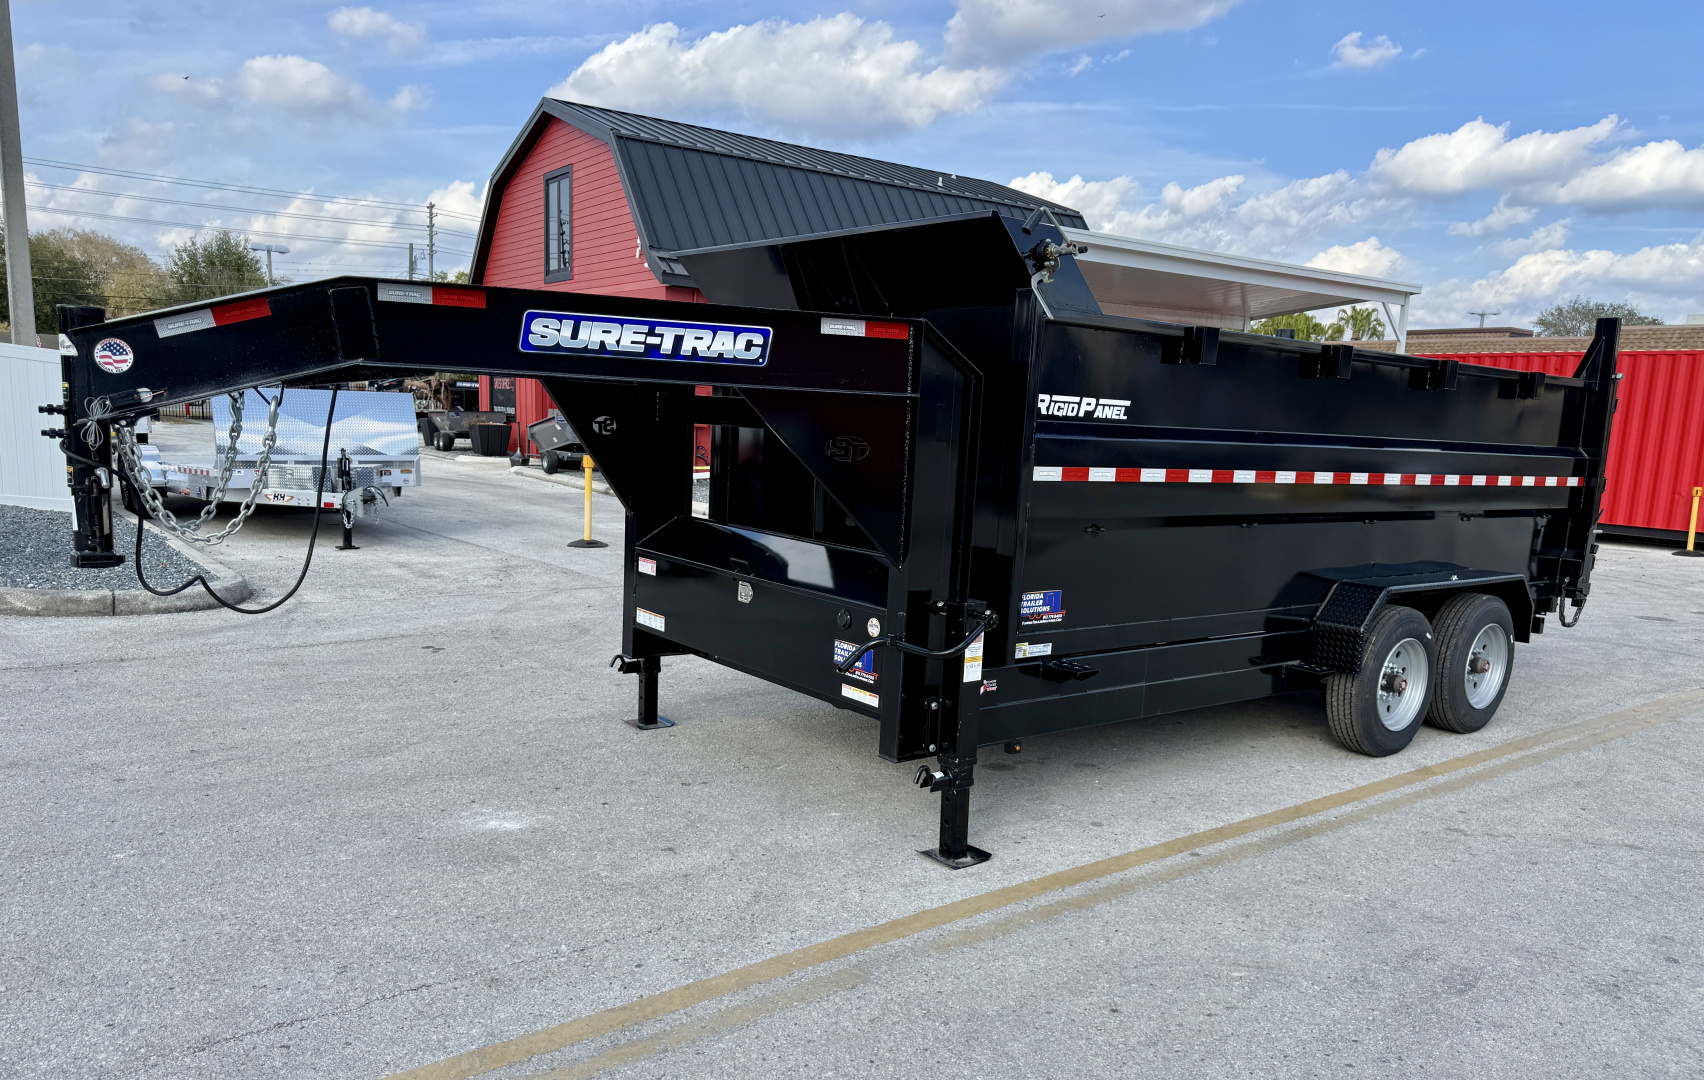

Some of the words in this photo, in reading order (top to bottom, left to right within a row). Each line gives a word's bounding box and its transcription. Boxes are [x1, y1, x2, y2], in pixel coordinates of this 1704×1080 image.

[528, 318, 764, 360] SURE-TRAC
[1038, 394, 1079, 417] RIGID
[1078, 397, 1128, 420] PANEL
